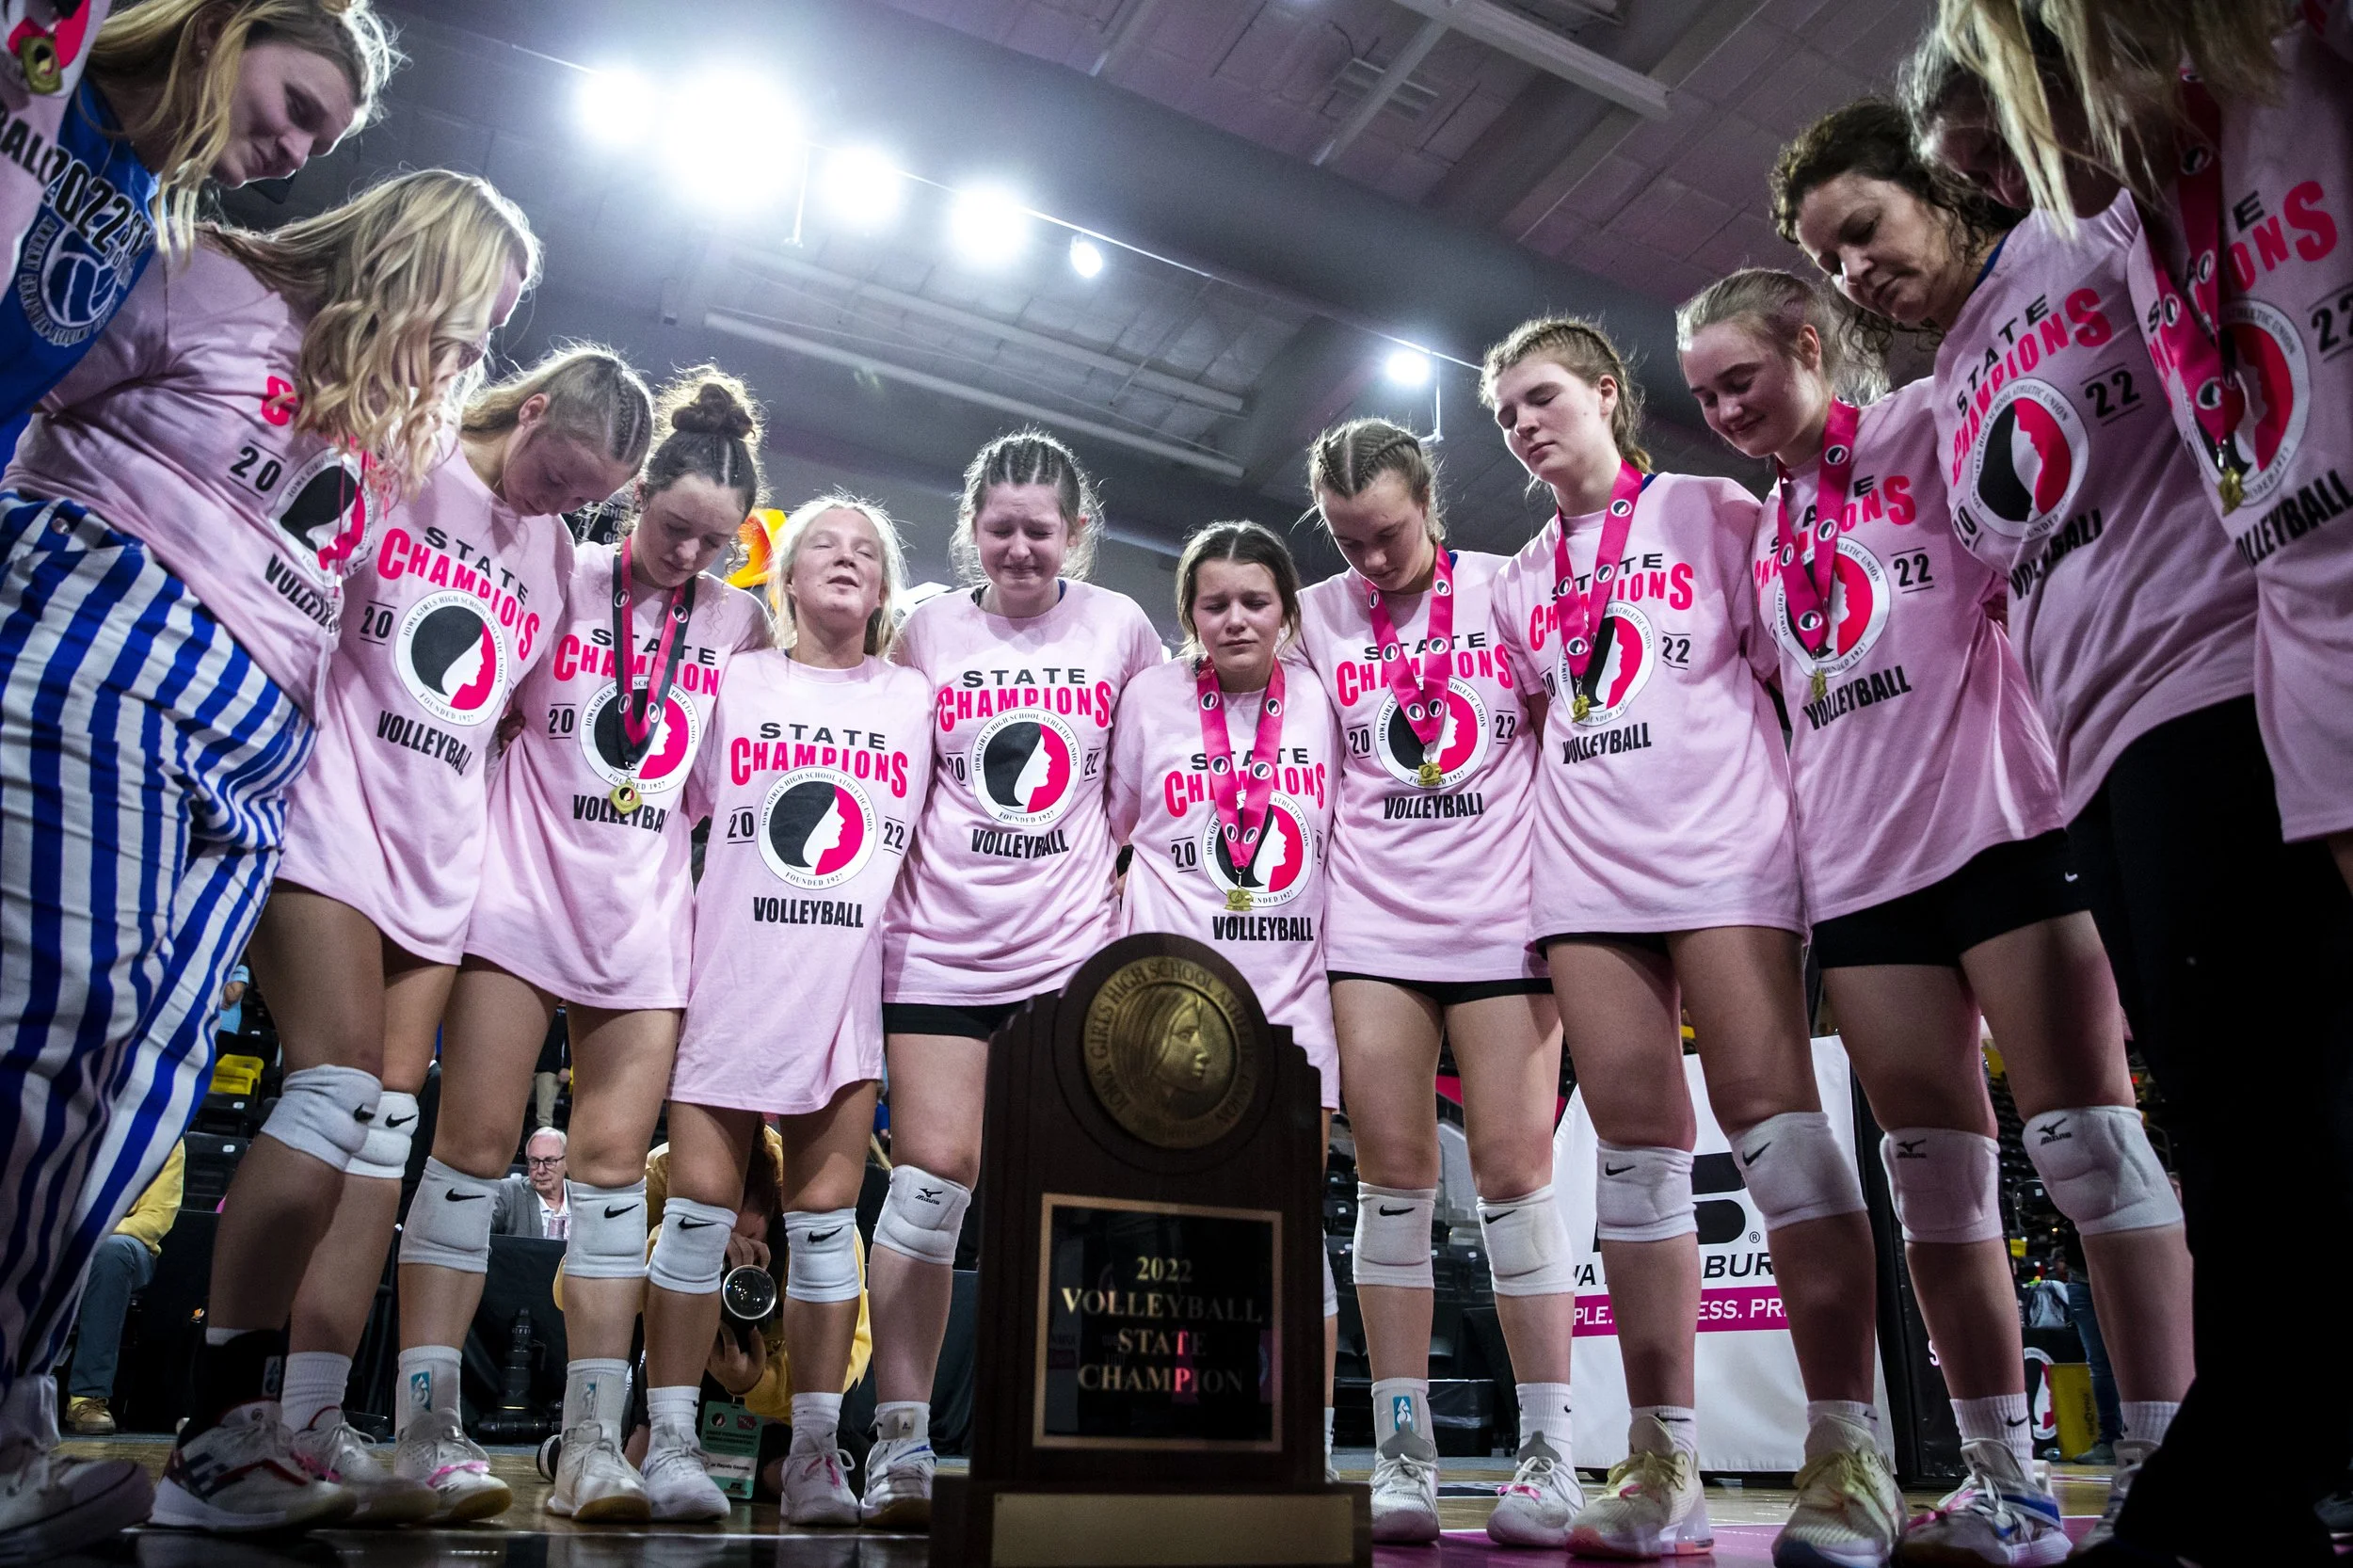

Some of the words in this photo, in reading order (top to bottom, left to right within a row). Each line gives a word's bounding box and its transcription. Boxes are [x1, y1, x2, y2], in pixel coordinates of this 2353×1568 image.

[1957, 295, 2049, 417] STATE
[1952, 288, 2112, 488] CHAMPIONS
[2085, 370, 2141, 419] 22
[1977, 423, 1990, 447] HIGH
[1989, 392, 2012, 422] SCHOOL
[2044, 392, 2069, 423] UNION
[230, 446, 281, 492] 20
[2026, 514, 2059, 537] UNDED
[2236, 469, 2353, 568] OLLEYBALL
[424, 527, 528, 605] STATE
[1551, 553, 1663, 601] TTE
[1894, 553, 1932, 587] 22
[1779, 614, 1788, 636] IOWA
[1837, 542, 1863, 559] HLETIC
[1863, 554, 1881, 583] UNION
[360, 606, 394, 639] 20
[403, 614, 419, 636] IOWA
[416, 598, 438, 617] GIRLS
[439, 595, 459, 604] HIGH
[460, 597, 488, 618] SCHOOL
[591, 629, 716, 665] SATE
[1364, 632, 1486, 661] SATE
[1662, 636, 1691, 664] 22
[962, 668, 1085, 688] STATE
[419, 693, 456, 719] FOUNDED
[585, 708, 595, 727] IOWA
[594, 689, 613, 711] GIRLS
[670, 690, 694, 716] THLETIC
[937, 680, 1112, 732] CHAMPIONS
[1382, 699, 1398, 722] GIRLS
[1449, 681, 1477, 707] THLETIC
[1476, 704, 1487, 728] UNION
[1802, 665, 1913, 730] VOLLEYBALL
[549, 709, 575, 734] 20
[760, 723, 886, 750] STATE
[1496, 714, 1516, 740] 22
[976, 730, 991, 752] GIRLS
[991, 718, 1008, 732] HIGH
[1010, 712, 1040, 722] SCHOOL
[1042, 716, 1073, 743] ATHLETIC
[1069, 743, 1078, 767] UNION
[1350, 728, 1370, 754] 20
[1562, 723, 1652, 764] VOLLEYBALL
[730, 737, 908, 798] CHAMPIONS
[947, 756, 966, 781] 20
[1084, 752, 1100, 776] 22
[1191, 748, 1309, 771] SATE
[1164, 762, 1325, 818] CHMIONS
[1449, 770, 1465, 783] 1927
[761, 807, 770, 826] IOWA
[767, 785, 785, 807] GIRLS
[784, 771, 804, 787] HIGH
[805, 771, 837, 783] SCHOOL
[838, 778, 868, 807] ATHLETIC
[863, 806, 872, 832] UNION
[998, 812, 1036, 824] FOUNDED
[1038, 810, 1055, 822] 1927
[1384, 792, 1484, 820] VOLLEYBALL
[727, 811, 755, 839] 20
[883, 822, 904, 850] 22
[1206, 835, 1214, 856] IOWA
[1273, 797, 1302, 824] ATHLETIC
[1300, 823, 1309, 847] UNION
[971, 828, 1069, 859] VOLLEYBALL
[1171, 840, 1196, 869] 20
[785, 872, 824, 887] FOUNDED
[826, 872, 843, 885] 1927
[1251, 895, 1279, 904] UNDED
[1279, 889, 1294, 903] 1927
[753, 897, 864, 928] VOLLEYBALL
[1212, 917, 1314, 941] VOLLEYBALL
[1090, 1004, 1114, 1060] GIRLS
[1104, 967, 1146, 1004] HIGH
[1148, 960, 1213, 992] SCHOOL
[1136, 1256, 1193, 1283] 2022
[1062, 1288, 1263, 1323] VOLLEYBALL
[1750, 1298, 1787, 1319] PR
[1117, 1328, 1207, 1356] STATE
[1078, 1364, 1243, 1395] CHAMPION
